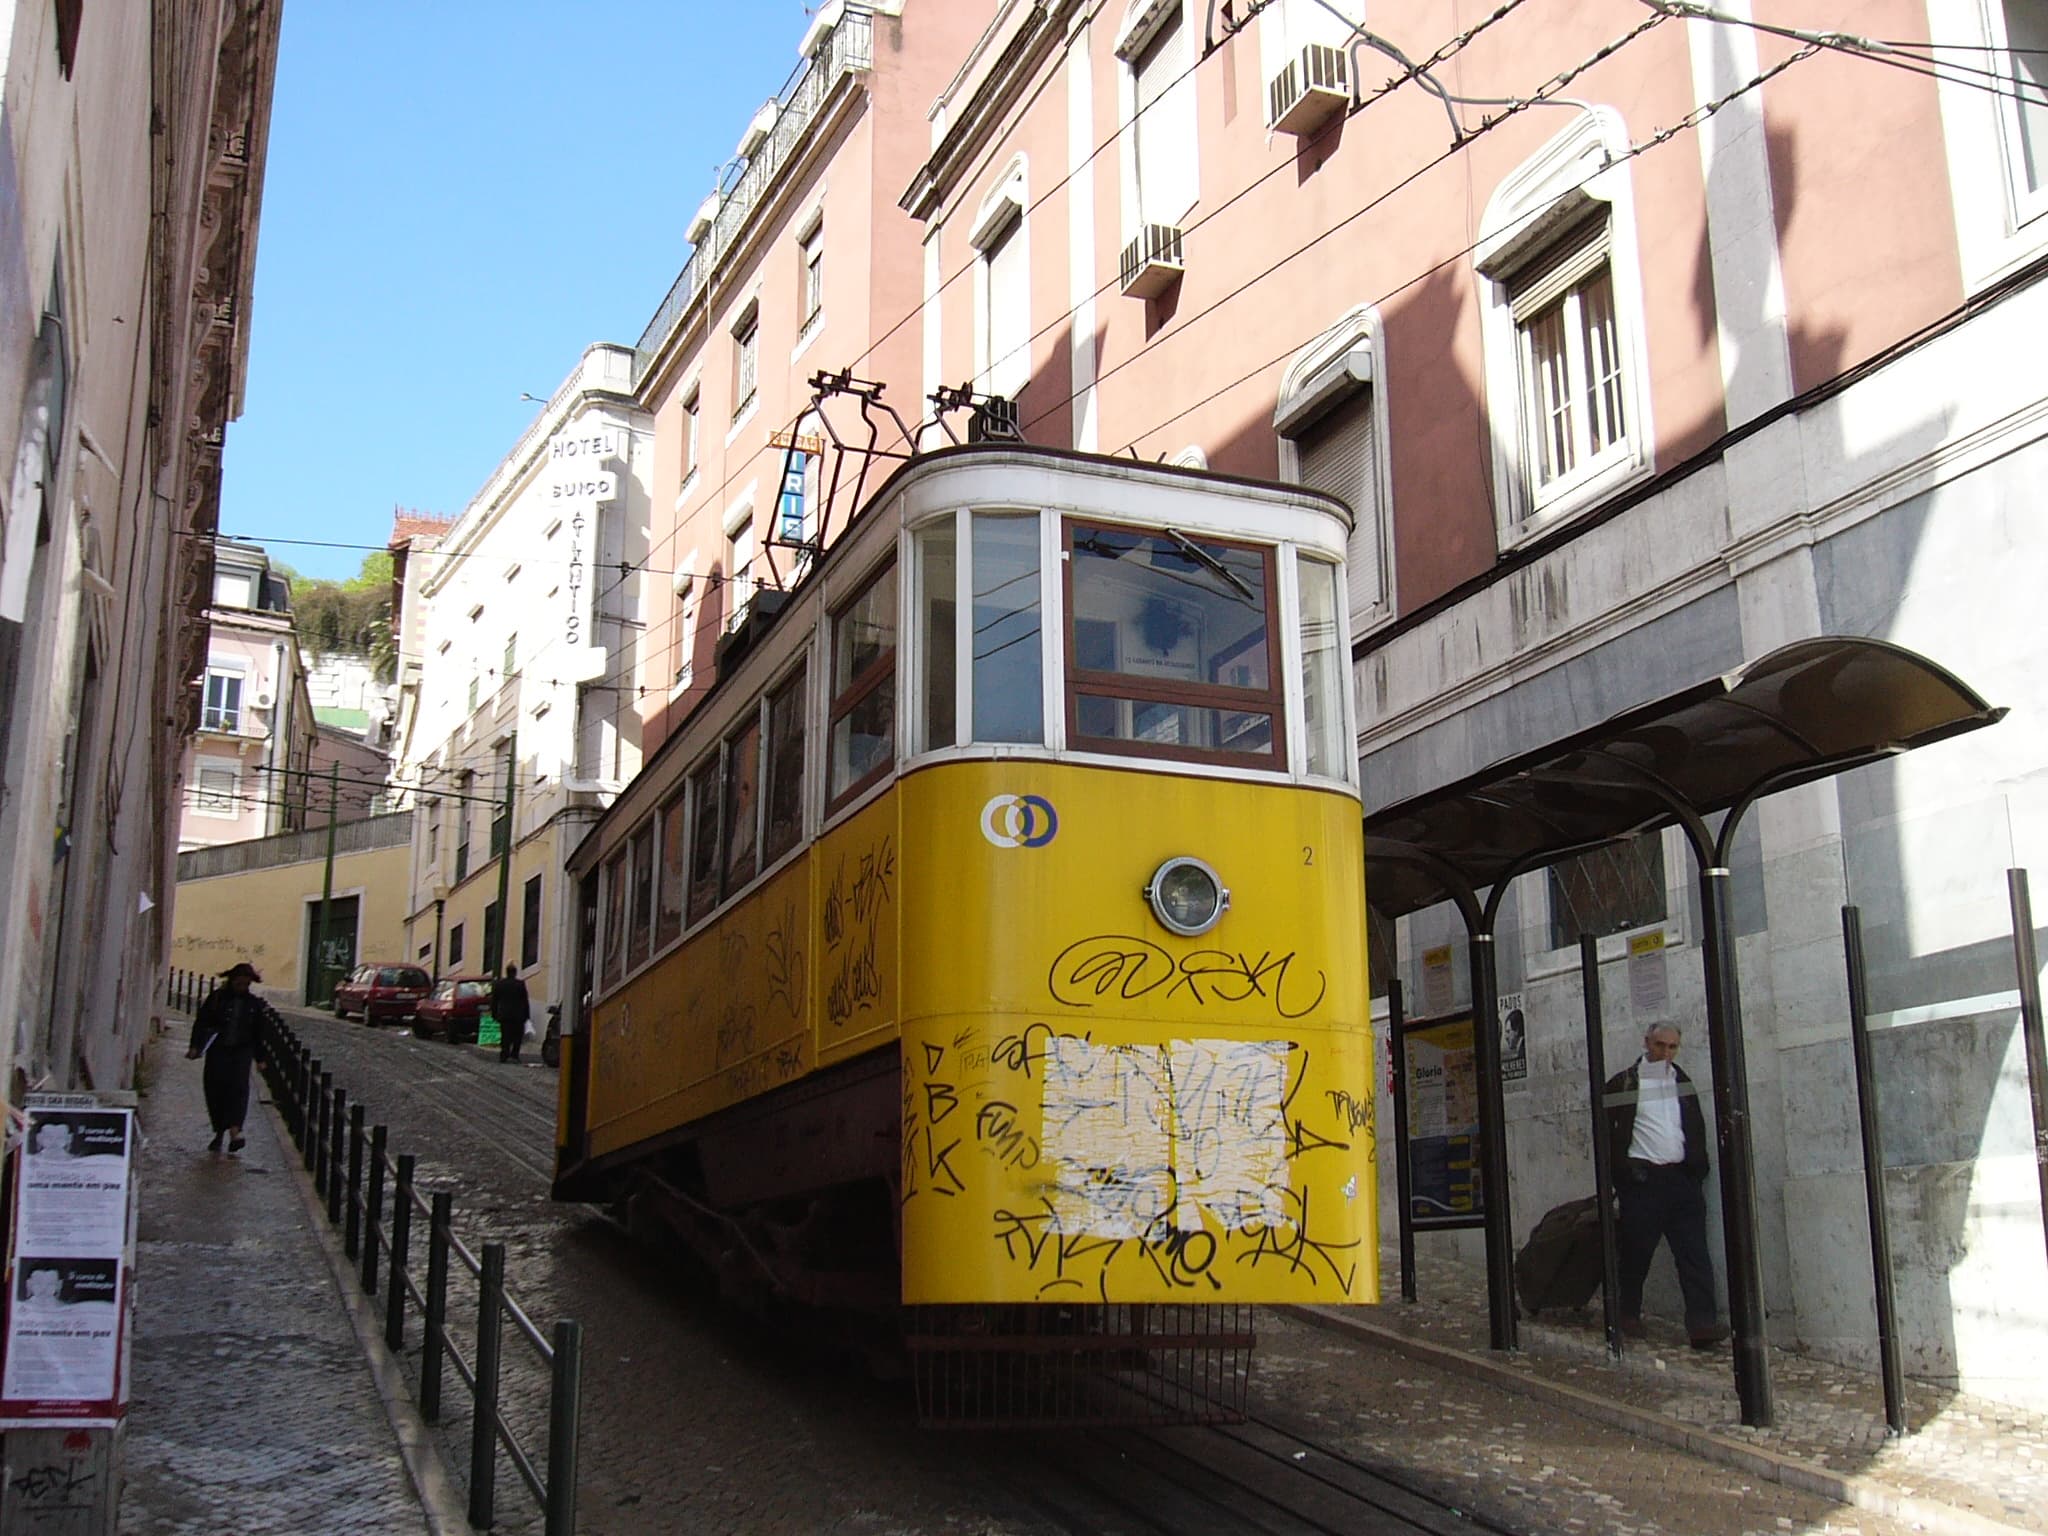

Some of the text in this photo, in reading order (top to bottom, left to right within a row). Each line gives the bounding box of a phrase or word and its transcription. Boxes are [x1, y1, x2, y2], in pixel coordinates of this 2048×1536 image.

[552, 435, 614, 459] HOTEL
[784, 452, 802, 537] IRIS
[1302, 846, 1313, 866] 2
